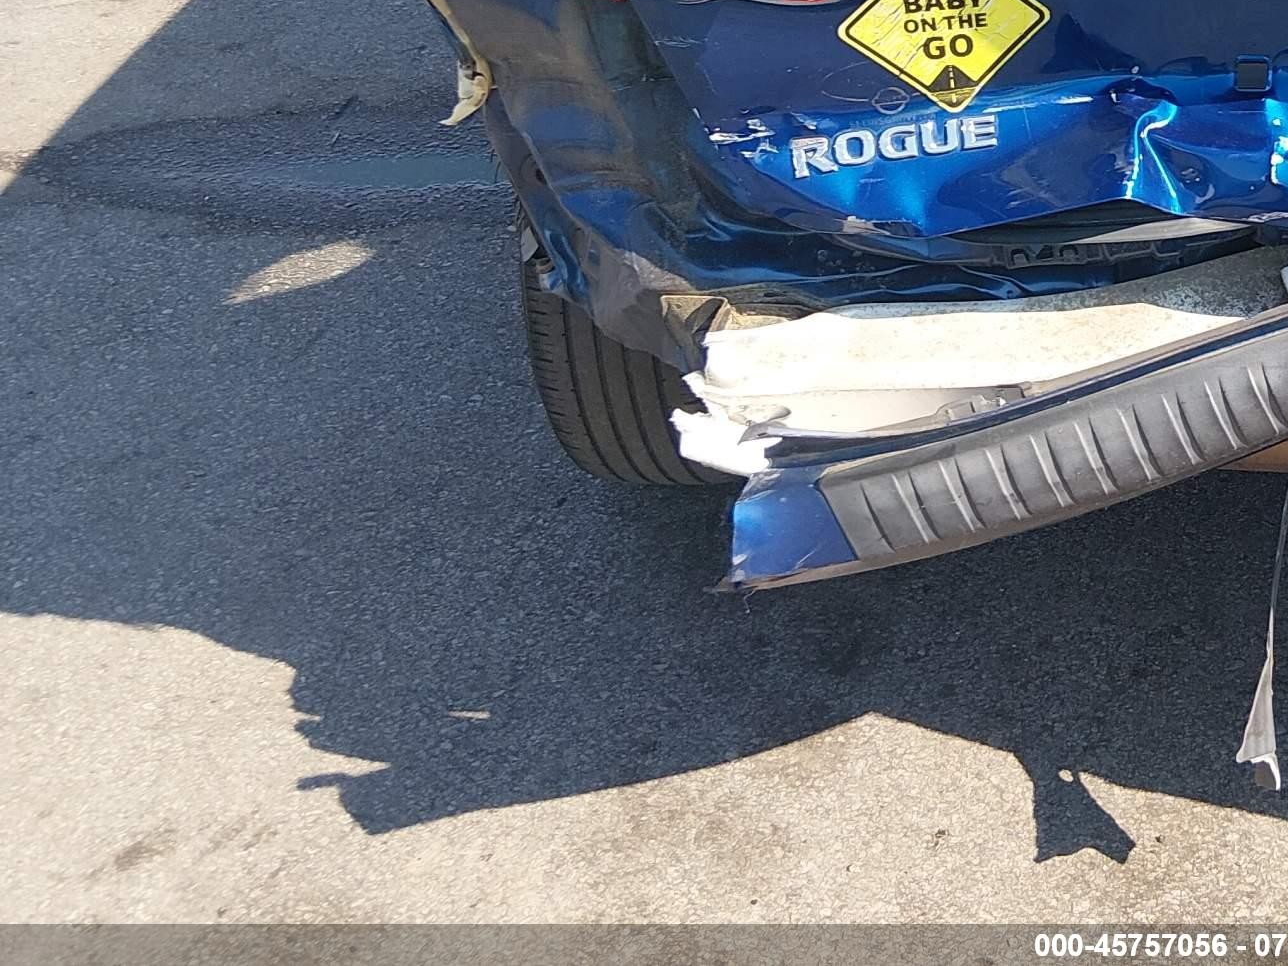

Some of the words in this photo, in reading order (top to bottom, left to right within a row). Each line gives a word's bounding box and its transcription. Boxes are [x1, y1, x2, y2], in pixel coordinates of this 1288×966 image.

[903, 18, 937, 33] ON
[946, 12, 988, 30] THE
[922, 33, 973, 60] GO
[789, 115, 998, 178] ROGUE
